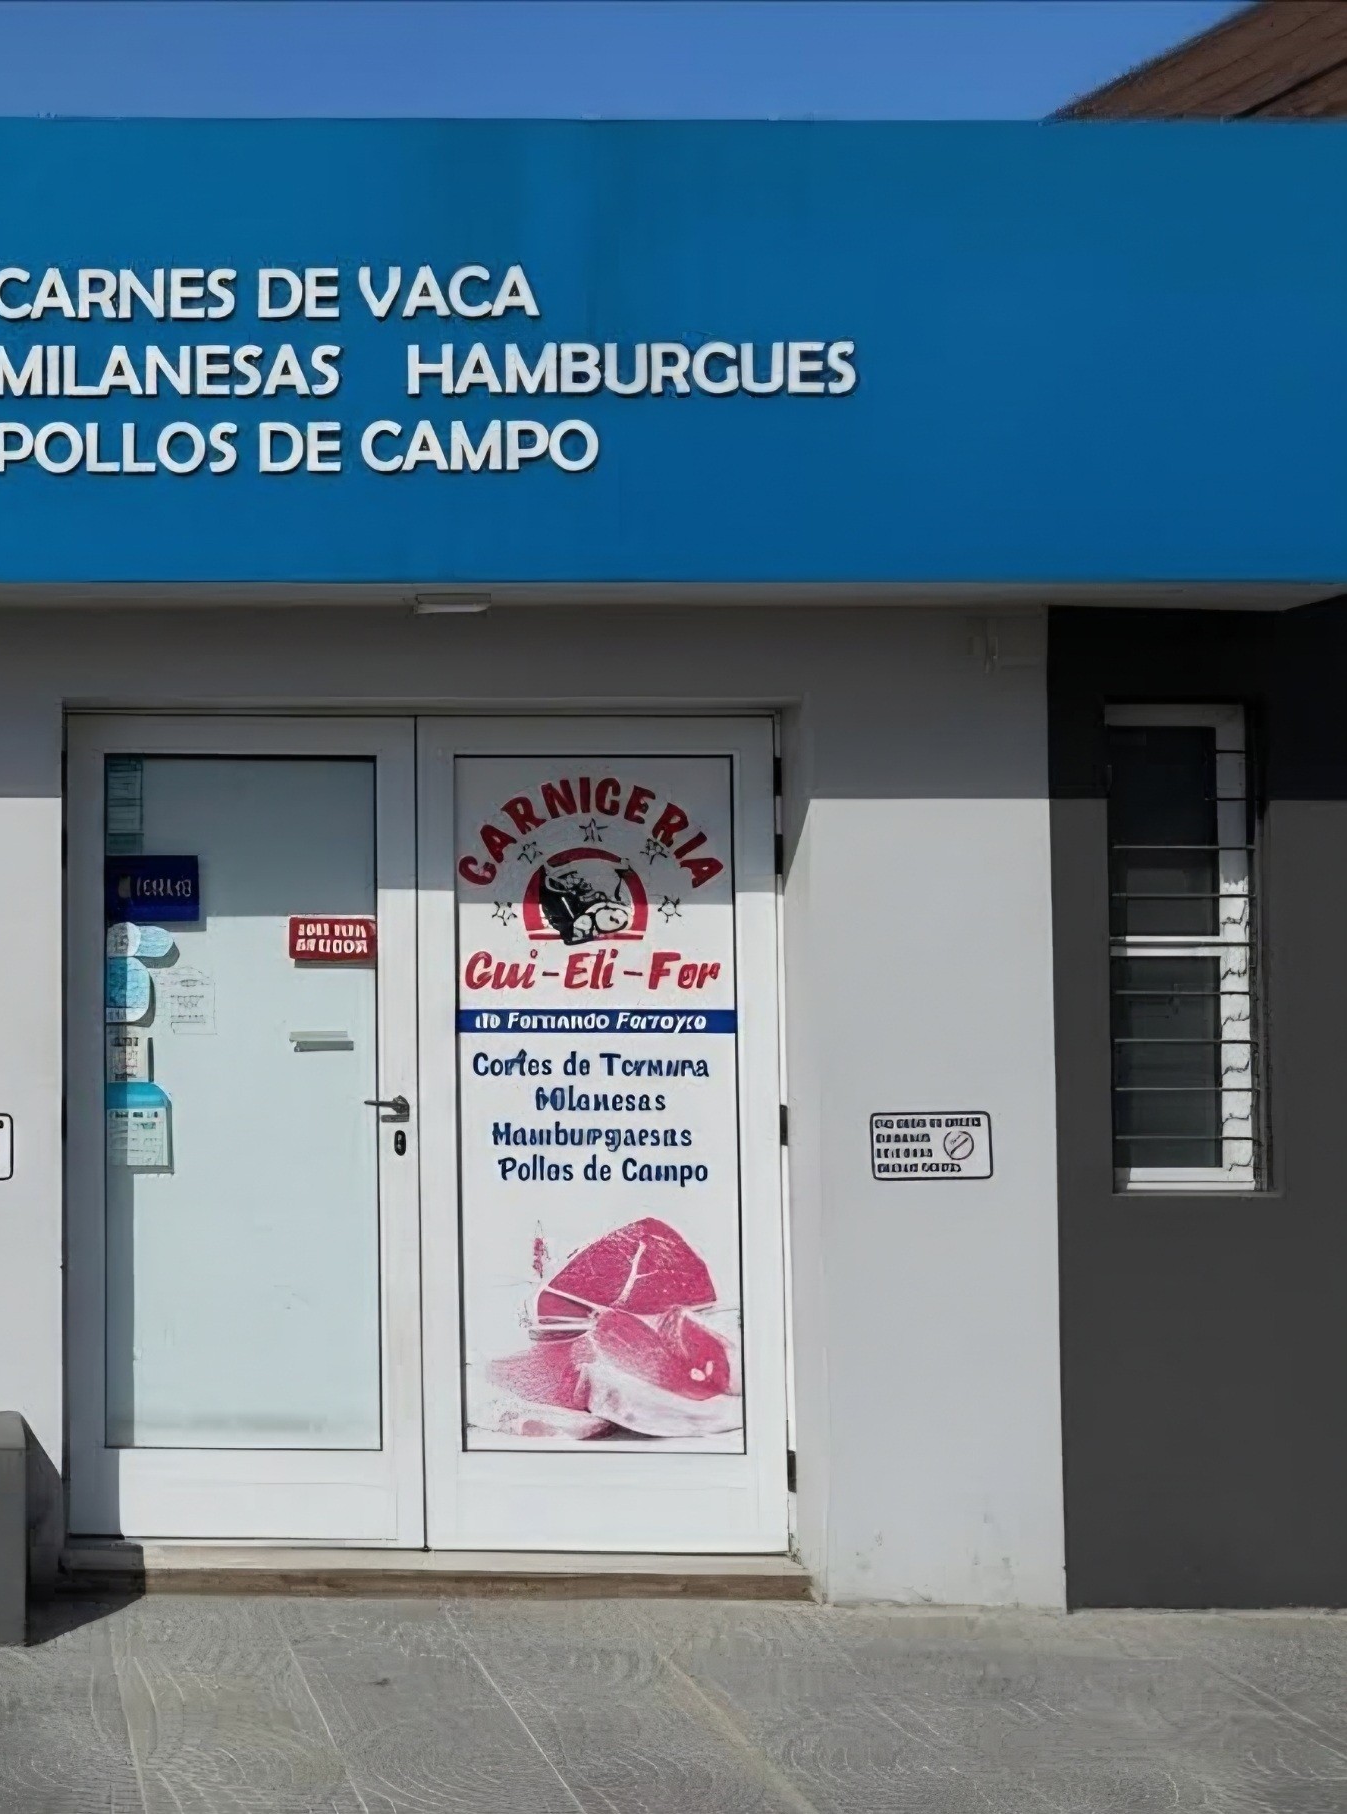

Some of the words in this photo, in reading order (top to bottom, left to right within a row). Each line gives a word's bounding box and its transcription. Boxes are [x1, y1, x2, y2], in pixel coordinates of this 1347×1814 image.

[258, 266, 340, 319] DE
[358, 265, 540, 318] VACA
[407, 341, 858, 395] HAMBURGUES
[259, 420, 342, 473] DE
[360, 419, 600, 473] CAMPO
[458, 776, 724, 888] CARNICERIA
[472, 1048, 552, 1077] Cortes
[562, 1050, 591, 1076] de
[497, 1154, 574, 1181] Pollos
[583, 1154, 612, 1181] de
[621, 1157, 709, 1188] Campo
